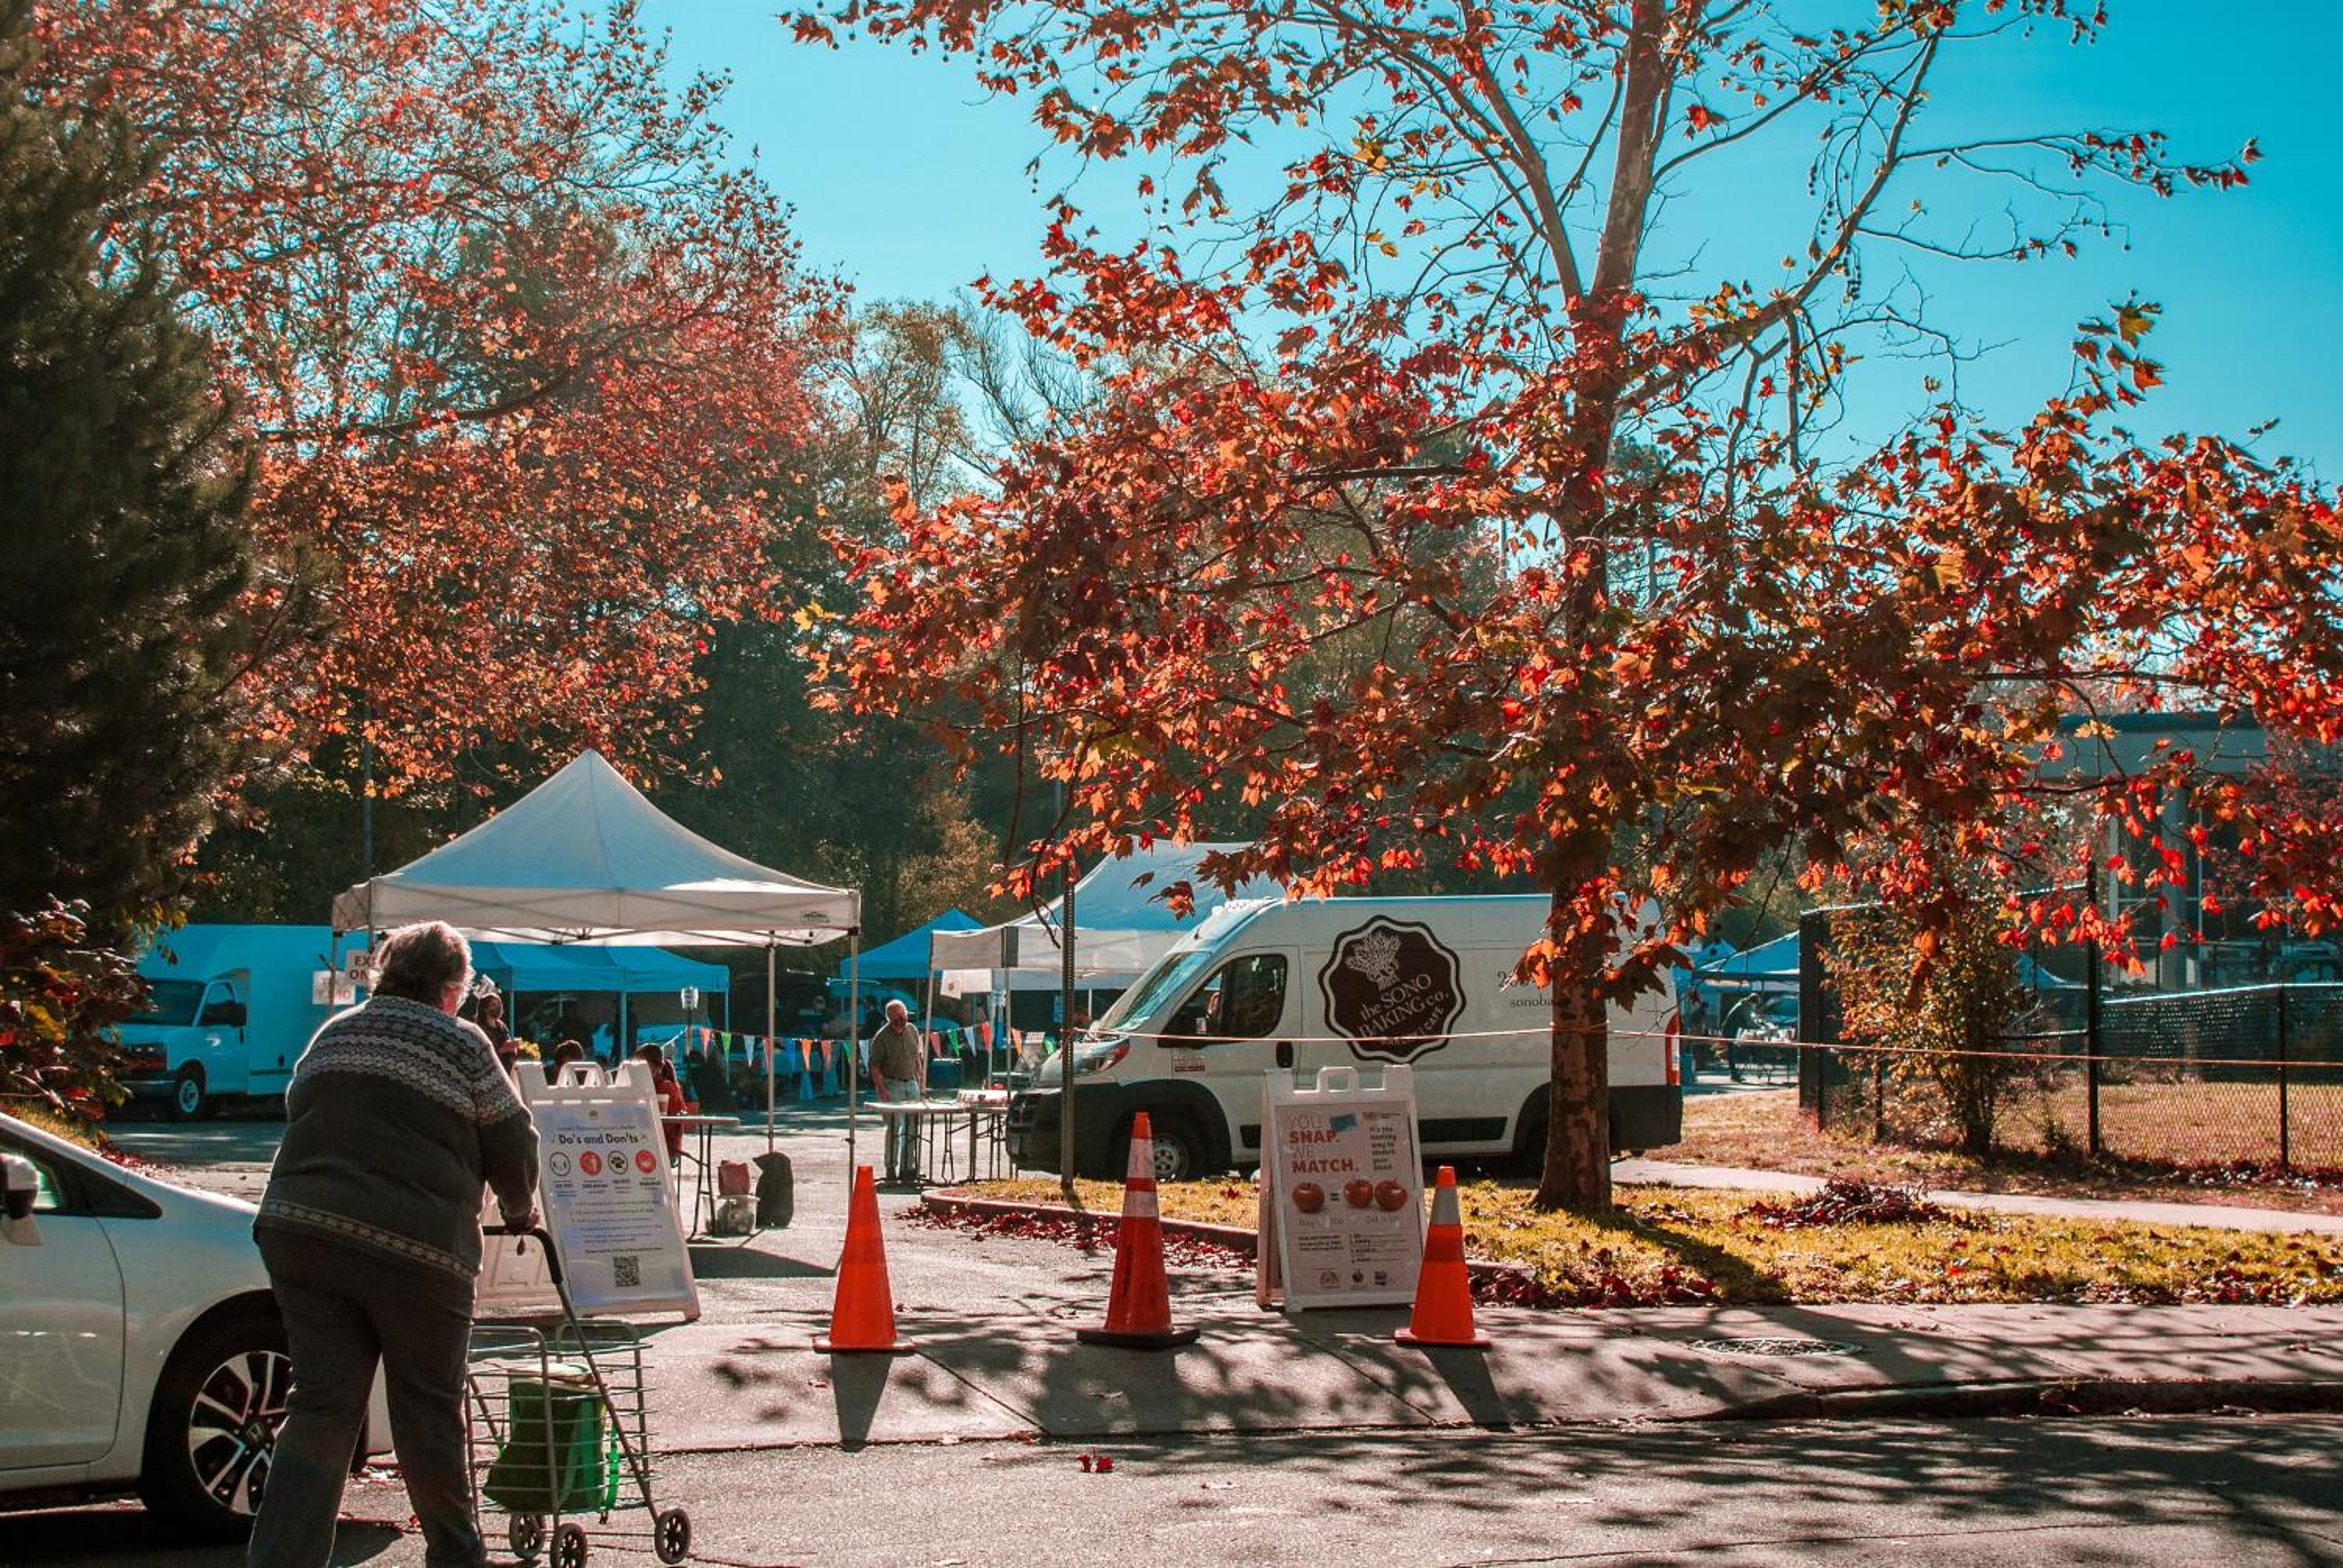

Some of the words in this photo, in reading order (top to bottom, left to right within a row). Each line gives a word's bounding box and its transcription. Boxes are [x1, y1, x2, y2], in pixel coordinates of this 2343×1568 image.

[1361, 1001, 1382, 1021] the
[1381, 974, 1432, 1008] SONO
[1357, 996, 1426, 1038] BAKING
[1287, 1112, 1322, 1129] YOU
[558, 1133, 582, 1145] Do's
[583, 1134, 604, 1144] and
[605, 1132, 639, 1144] Don'ts
[1289, 1130, 1341, 1144] SNAP.
[1291, 1158, 1360, 1174] MATCH.
